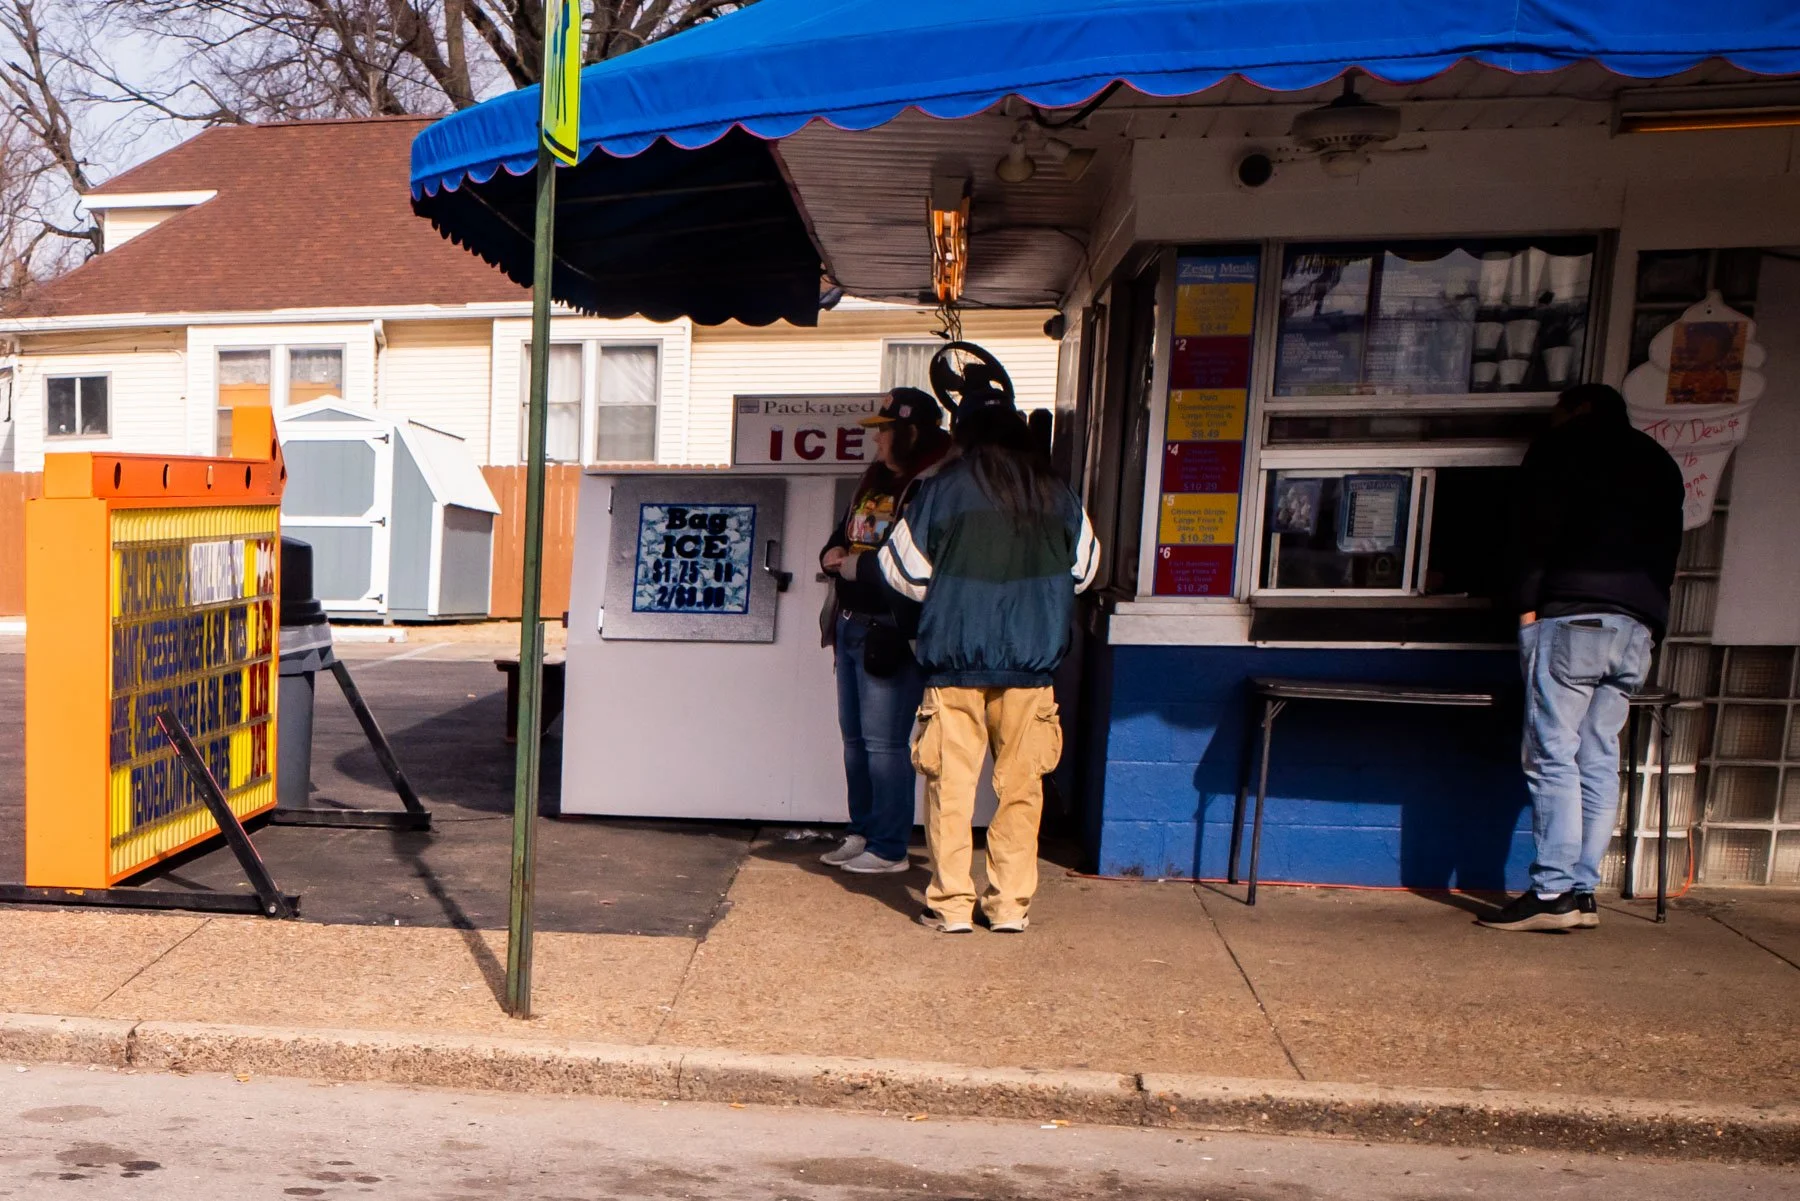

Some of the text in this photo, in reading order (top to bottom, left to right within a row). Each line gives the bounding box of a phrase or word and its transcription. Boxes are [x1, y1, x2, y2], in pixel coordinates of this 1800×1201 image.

[763, 400, 875, 416] Packaged
[770, 423, 866, 461] ICE
[665, 508, 729, 535] Bag
[662, 535, 730, 559] ICE
